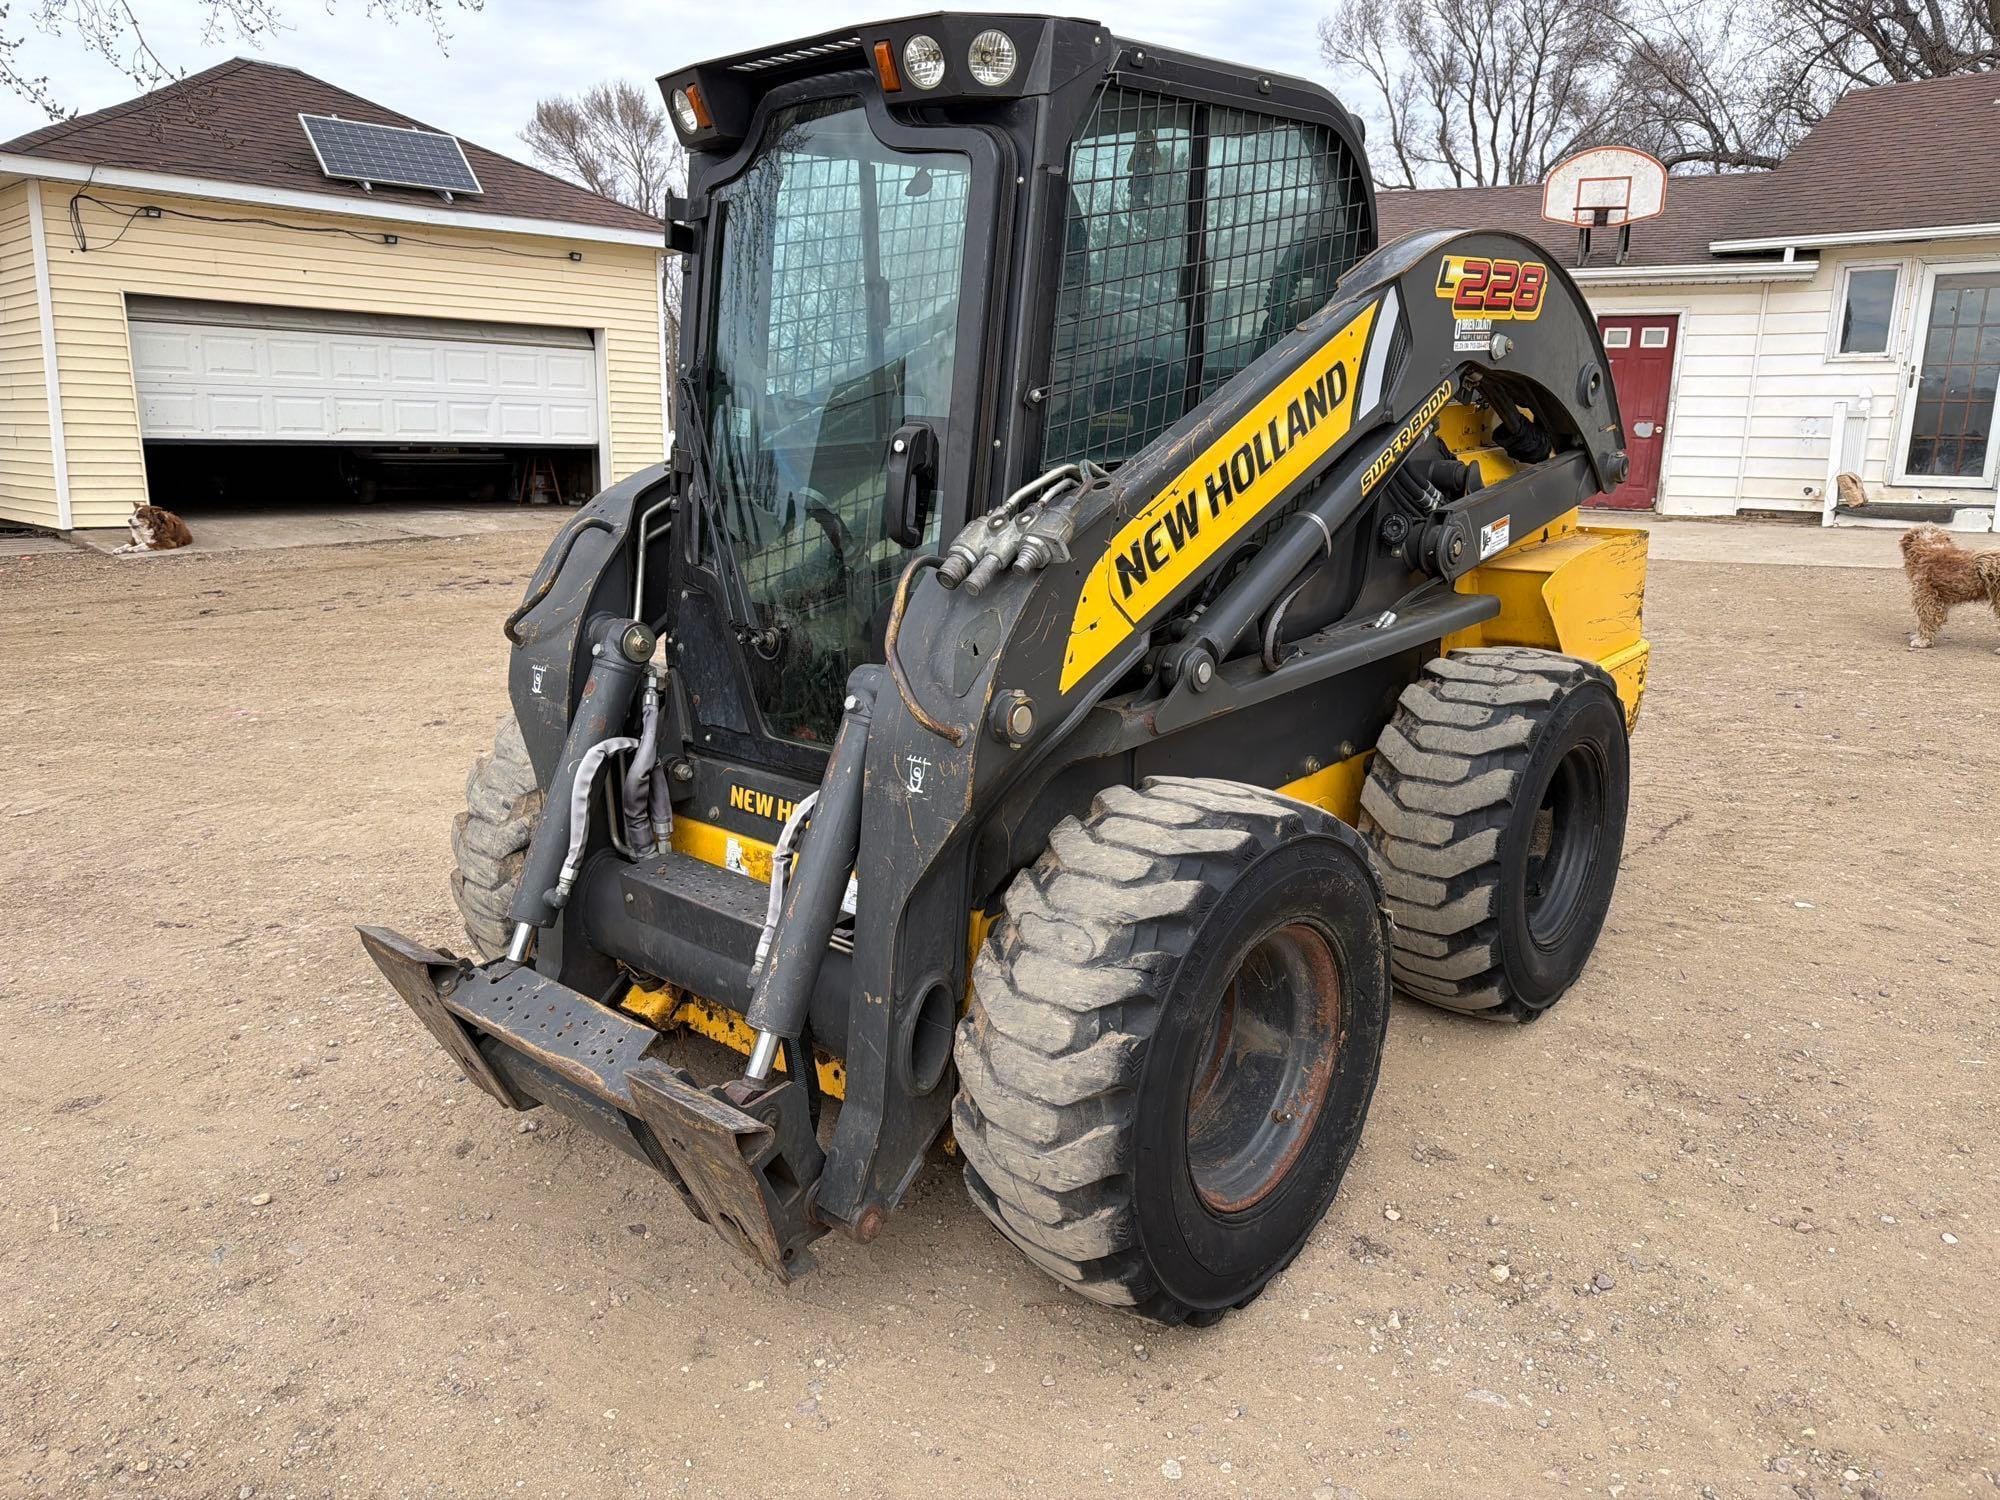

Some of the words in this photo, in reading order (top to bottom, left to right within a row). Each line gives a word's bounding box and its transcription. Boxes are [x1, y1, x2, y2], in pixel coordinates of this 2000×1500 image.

[1436, 256, 1548, 319] L228
[1114, 488, 1201, 600] NEW
[1204, 360, 1348, 520] HOLLAND
[1361, 427, 1412, 496] SUPER
[1410, 380, 1452, 439] BOOM
[730, 785, 774, 819] NEW
